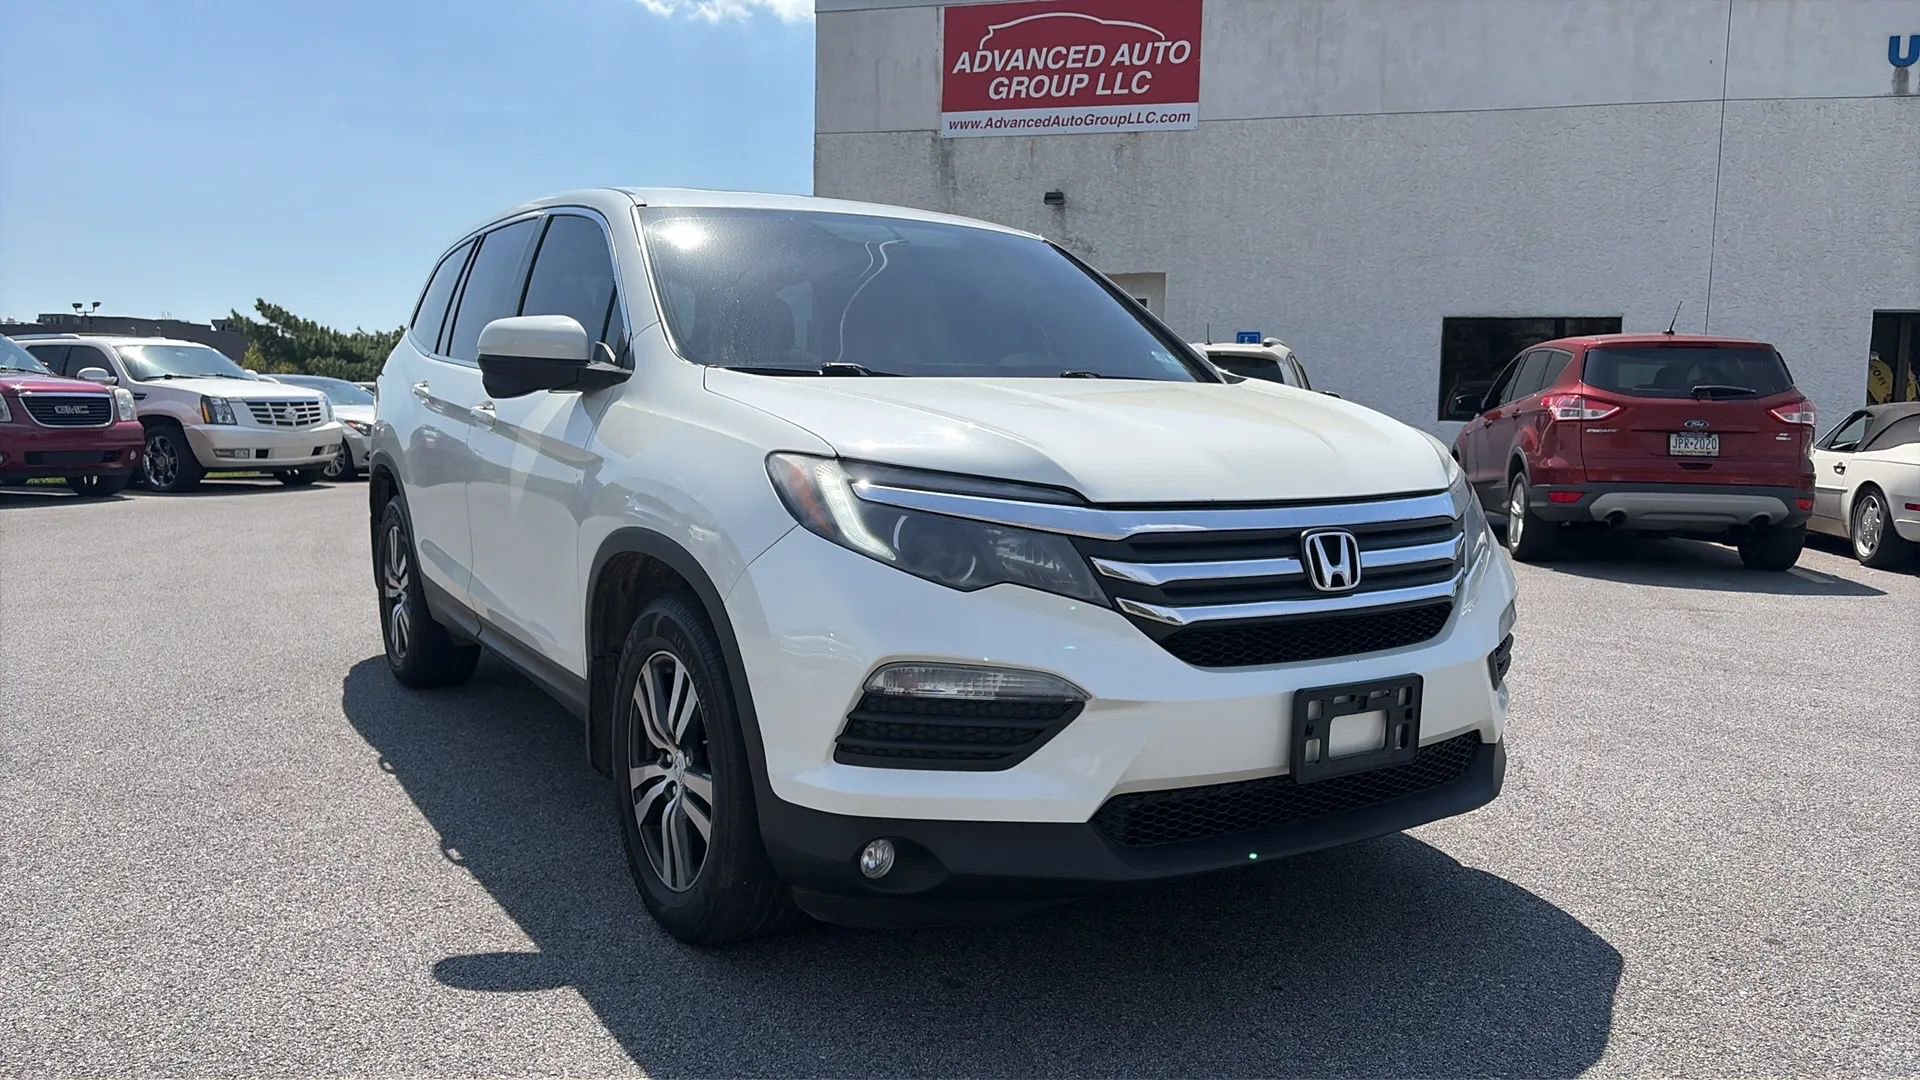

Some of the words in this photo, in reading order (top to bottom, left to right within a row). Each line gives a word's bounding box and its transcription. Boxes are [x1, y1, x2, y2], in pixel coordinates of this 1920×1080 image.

[952, 45, 1106, 74] ADVANCED
[1110, 40, 1192, 67] AUTO
[988, 73, 1090, 100] GROUP
[1095, 70, 1153, 95] LLC
[949, 111, 1191, 130] www.AdvancedAutoGroupLLC.com
[54, 405, 90, 415] GMC
